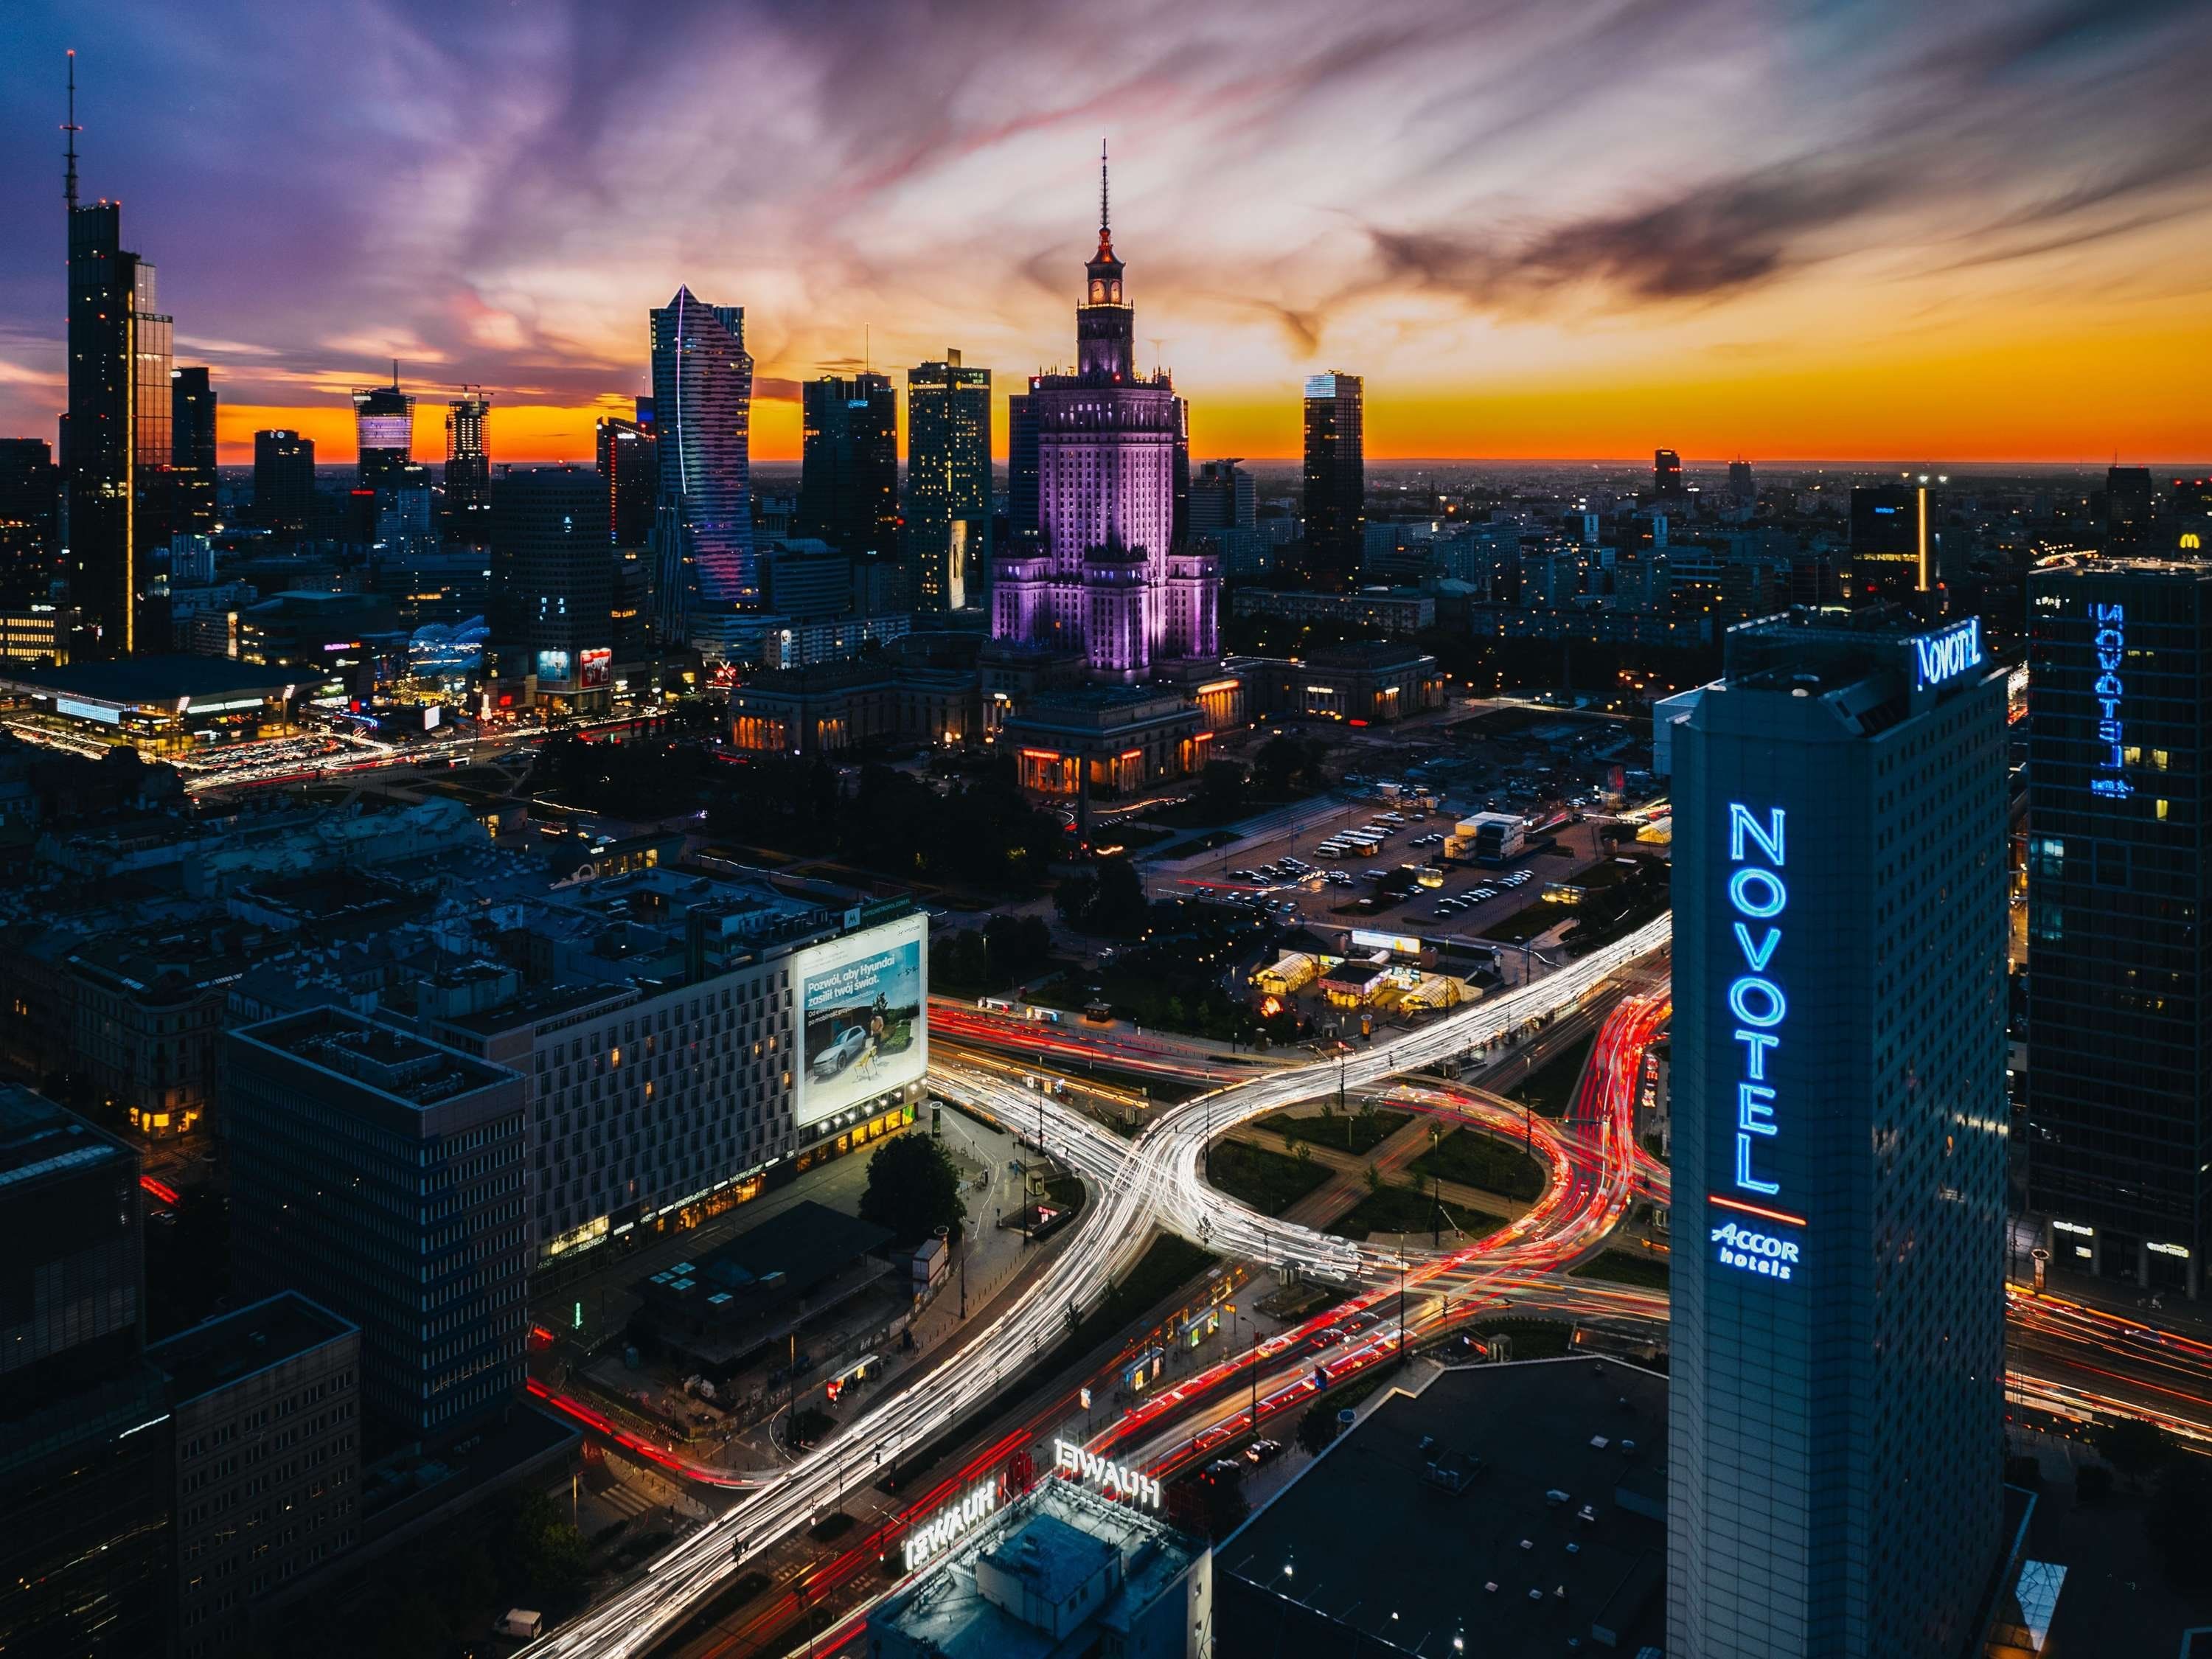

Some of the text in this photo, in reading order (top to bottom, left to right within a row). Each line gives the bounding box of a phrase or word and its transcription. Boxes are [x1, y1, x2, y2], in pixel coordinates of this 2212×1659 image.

[1917, 619, 1981, 692] NOVOTEL
[808, 973, 841, 994] Pozwól,
[843, 969, 860, 981] aby
[860, 954, 895, 975] Hyundai
[834, 982, 853, 997] twój
[855, 974, 880, 990] świat.
[1728, 802, 1787, 1196] NOVOTEL
[1711, 1222, 1799, 1263] ACCOR
[1720, 1247, 1791, 1279] hotels
